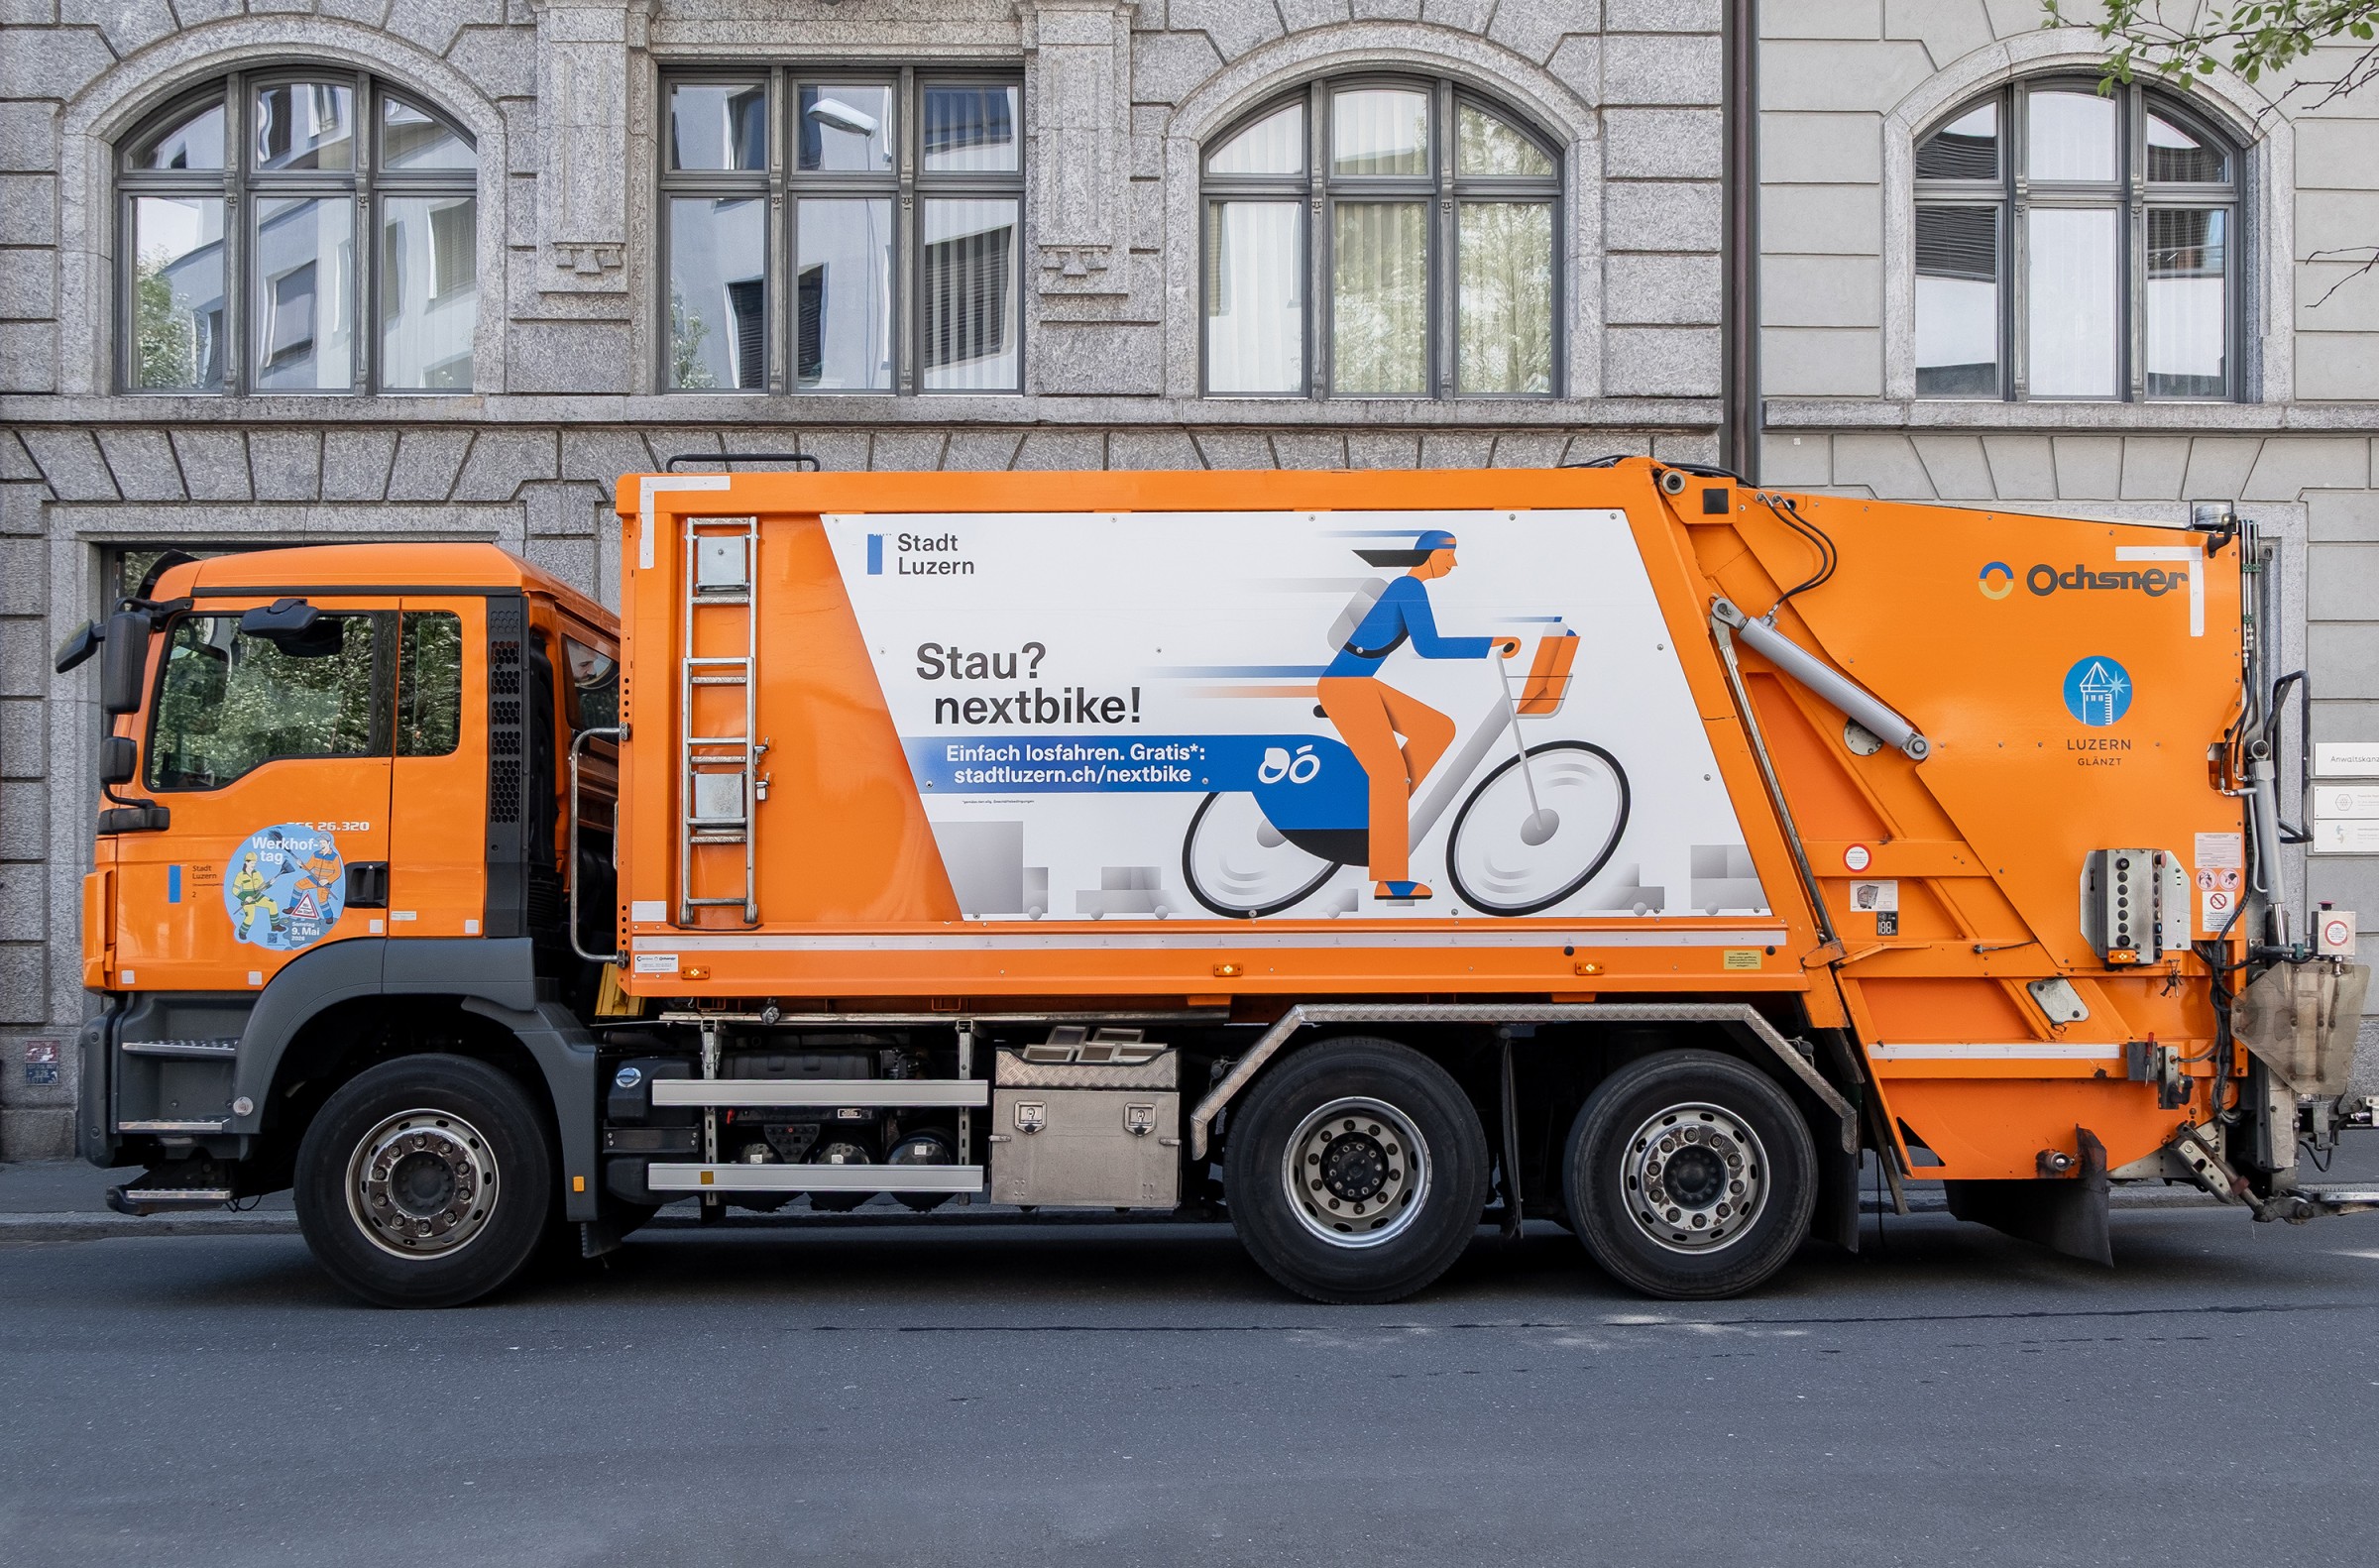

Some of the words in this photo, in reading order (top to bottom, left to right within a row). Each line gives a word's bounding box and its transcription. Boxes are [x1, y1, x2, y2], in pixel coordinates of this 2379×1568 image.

[897, 532, 959, 552] Stadt
[898, 556, 974, 575] Luzern
[2026, 563, 2189, 598] Ochsner
[916, 641, 1047, 680] Stau?
[935, 686, 1141, 725] nextbike!
[946, 744, 1021, 762] Einfach
[1026, 743, 1125, 761] losfahren.
[2067, 738, 2131, 750] LUZERN
[2077, 756, 2122, 766] GLÄNZT
[954, 765, 1191, 784] stadtluzern.ch/nextbike
[317, 821, 370, 832] 26.320
[252, 837, 319, 850] Werkhof-
[260, 850, 283, 864] tag
[291, 927, 300, 936] 9.
[301, 927, 320, 936] Mai
